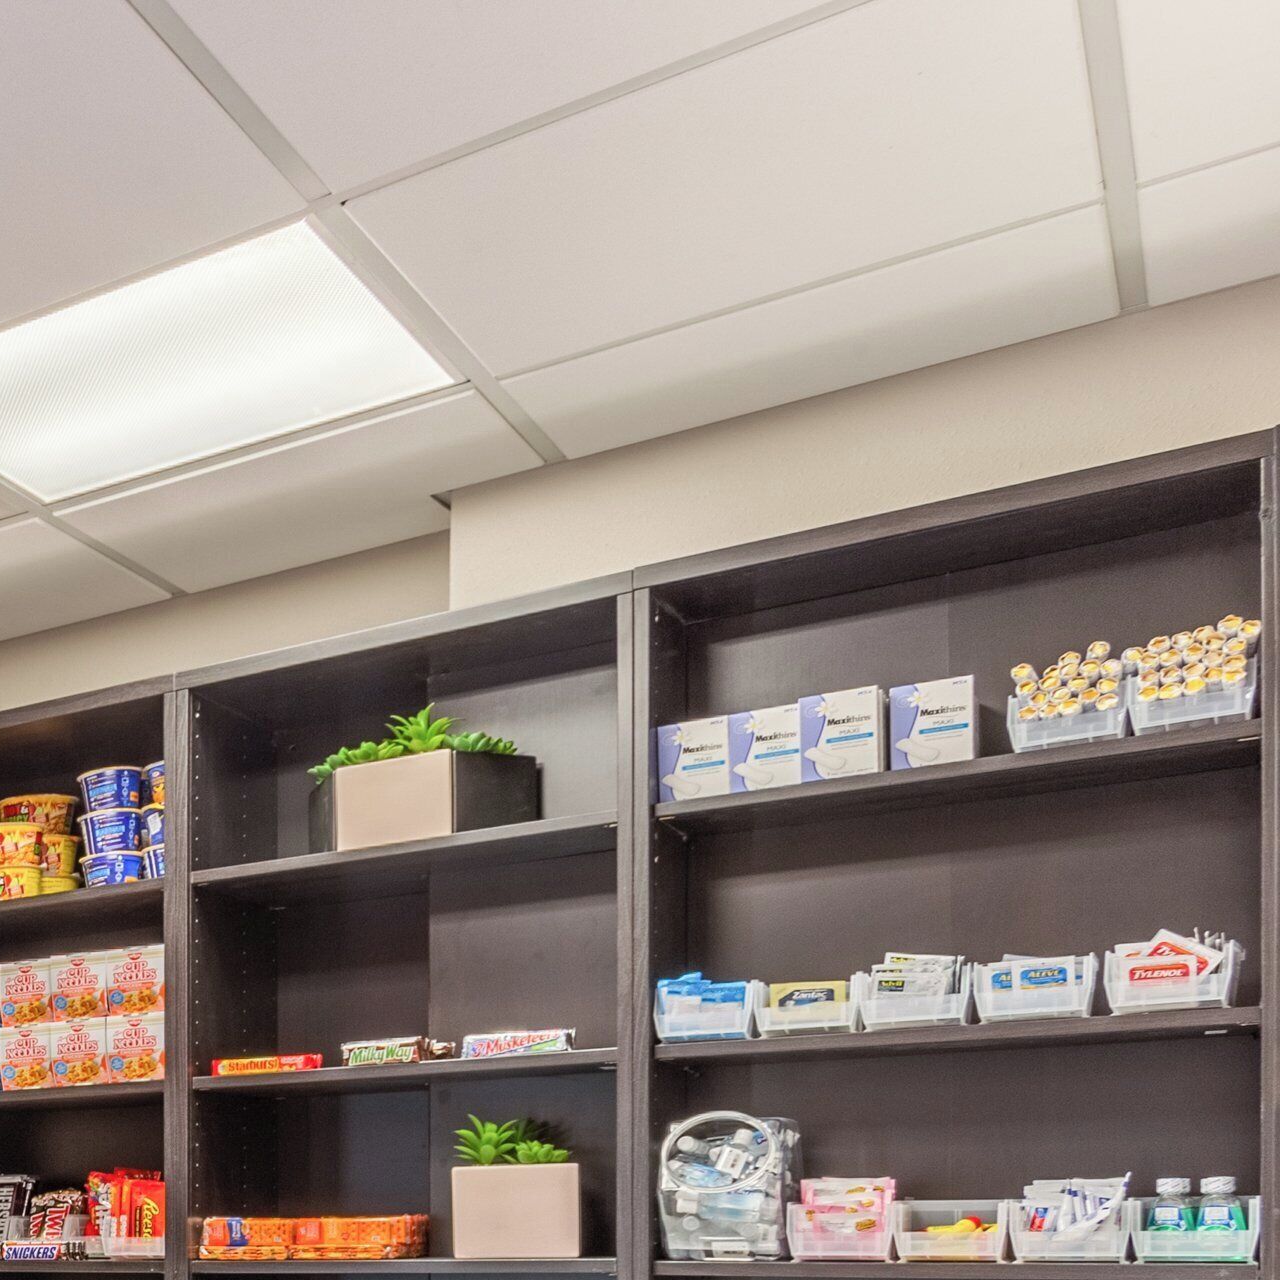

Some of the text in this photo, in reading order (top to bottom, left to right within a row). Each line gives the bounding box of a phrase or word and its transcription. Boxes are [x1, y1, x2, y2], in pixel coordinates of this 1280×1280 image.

[920, 704, 967, 718] Maxithins
[827, 714, 872, 727] Maxithins
[755, 731, 797, 744] Maxithins
[682, 743, 723, 755] Maxithins
[66, 967, 90, 979] CUP
[123, 961, 147, 972] CUP
[15, 974, 36, 986] CUP
[114, 969, 156, 983] NOODLES
[1132, 970, 1184, 980] TYLENOL
[6, 982, 45, 995] NOODLES
[58, 975, 98, 989] NOODLES
[792, 990, 828, 1000] Zantac
[66, 1033, 90, 1044] CUP
[124, 1027, 147, 1039] CUP
[15, 1038, 38, 1050] CUP
[58, 1040, 98, 1054] NOODLES
[114, 1036, 156, 1050] NOODLES
[6, 1046, 46, 1059] NOODLES
[349, 1043, 413, 1065] Milky Way
[473, 1044, 484, 1058] 3
[227, 1060, 277, 1072] Starburst
[5, 1246, 56, 1260] SNICKERS
